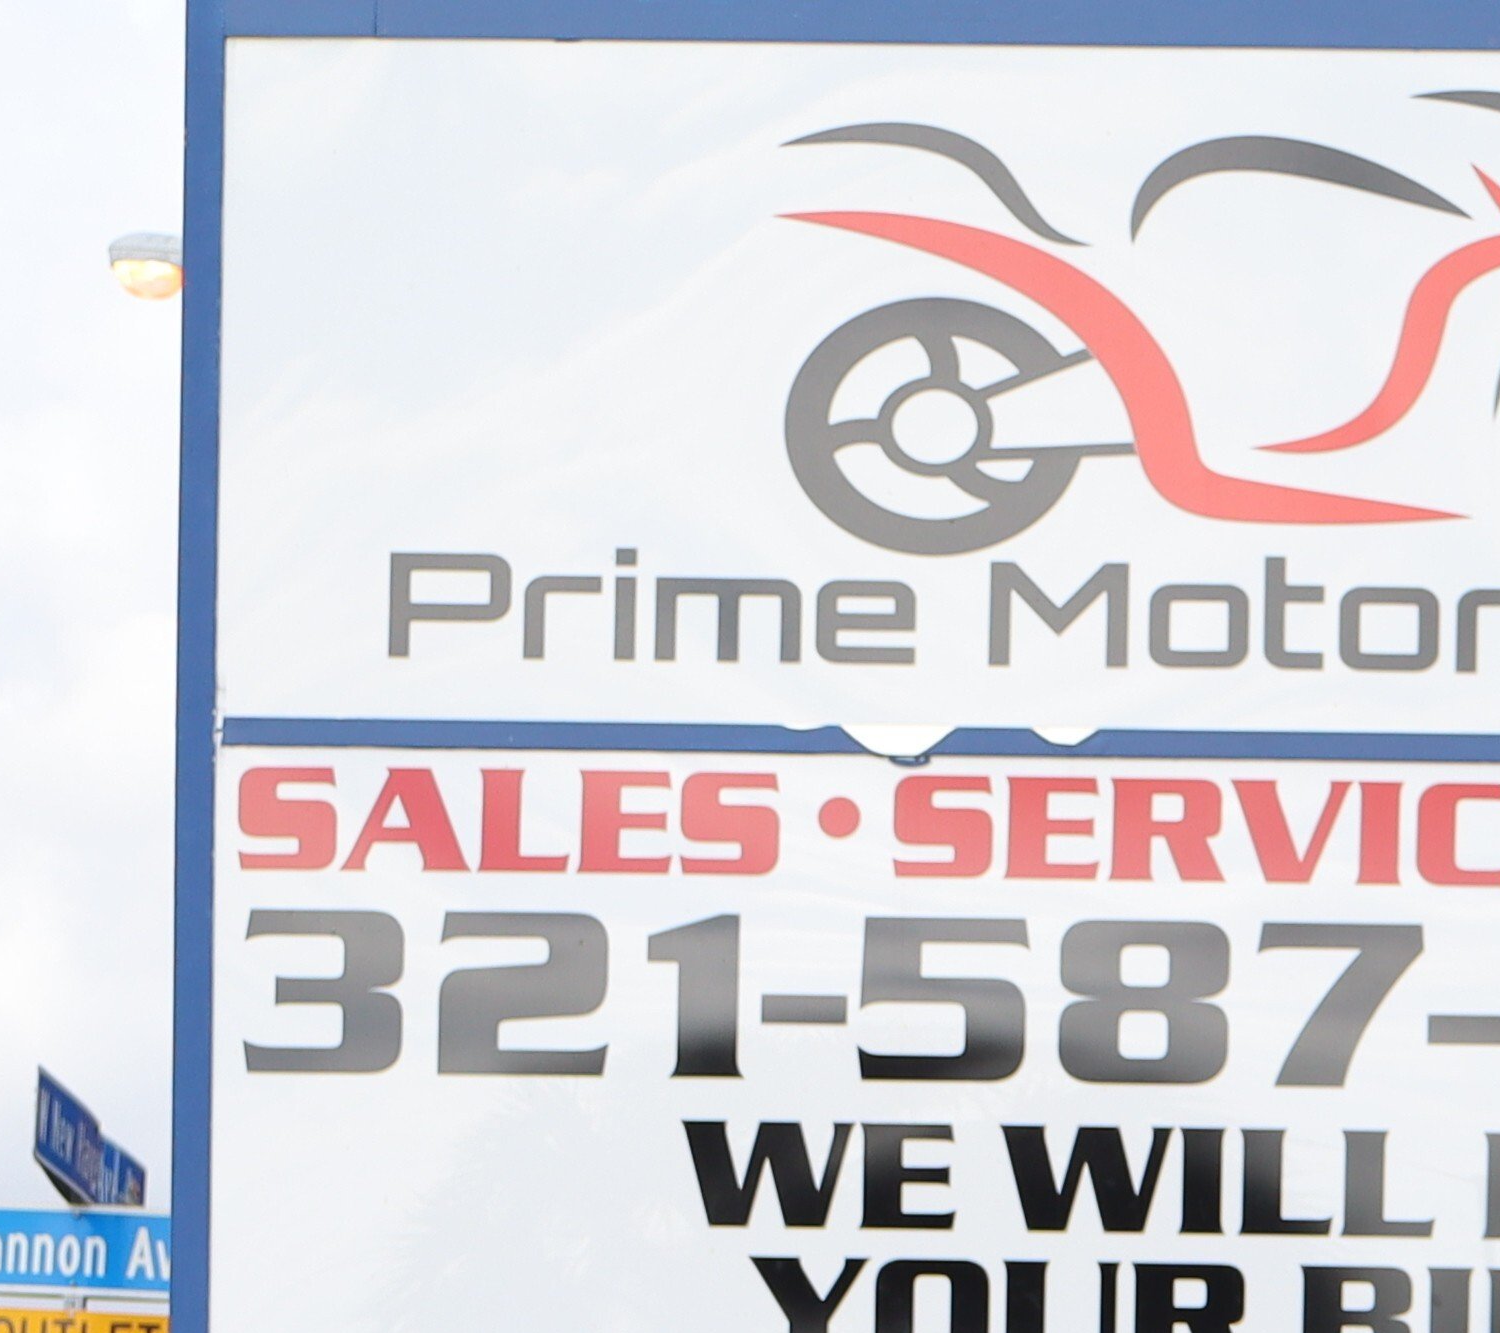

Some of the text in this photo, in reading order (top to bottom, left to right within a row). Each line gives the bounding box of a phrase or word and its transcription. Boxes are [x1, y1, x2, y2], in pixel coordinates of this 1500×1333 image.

[388, 548, 916, 665] Prime
[238, 767, 779, 876] SALES
[681, 1119, 956, 1232] WE
[1000, 1124, 1434, 1239] WILL
